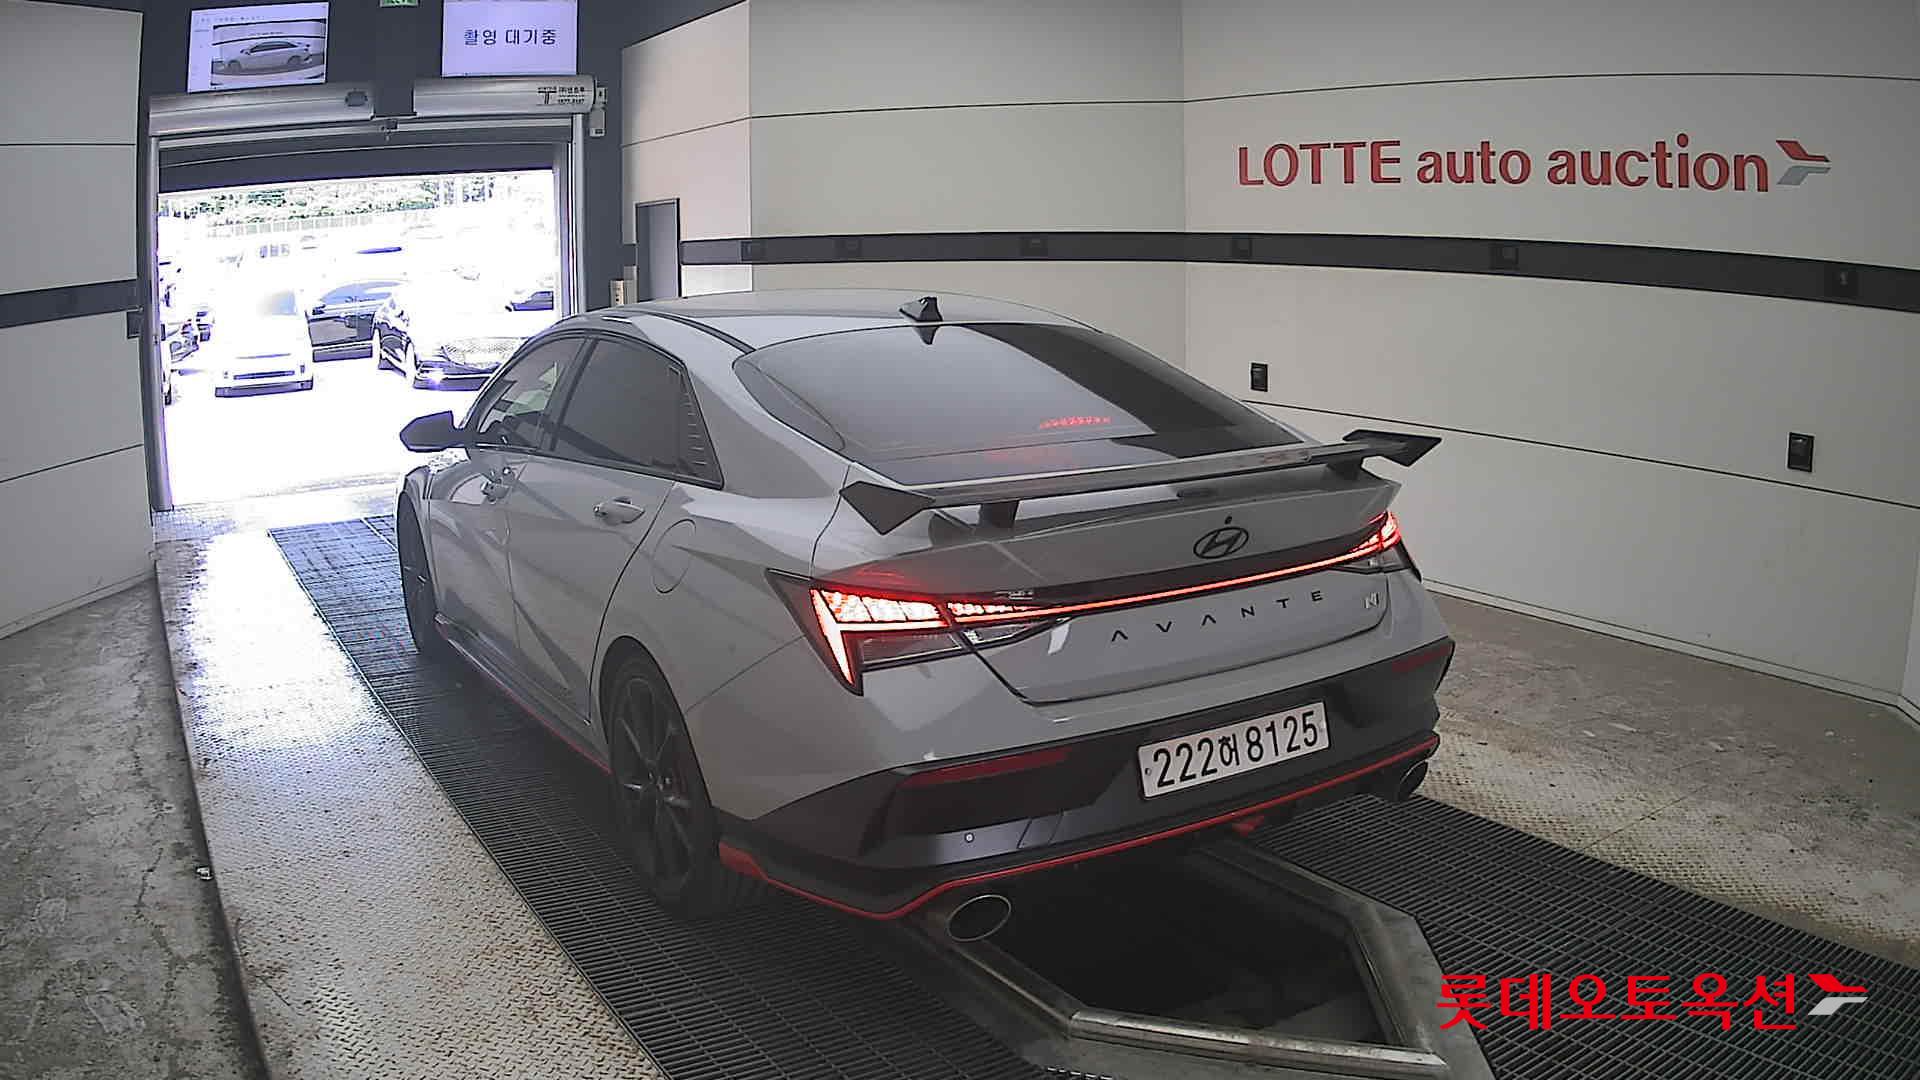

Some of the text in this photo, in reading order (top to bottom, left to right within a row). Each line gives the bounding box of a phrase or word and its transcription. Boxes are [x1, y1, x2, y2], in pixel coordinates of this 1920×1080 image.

[464, 29, 556, 46] 촬영 대기중
[1238, 133, 1769, 193] LOTTE auto auction
[1111, 591, 1323, 642] AVANTE
